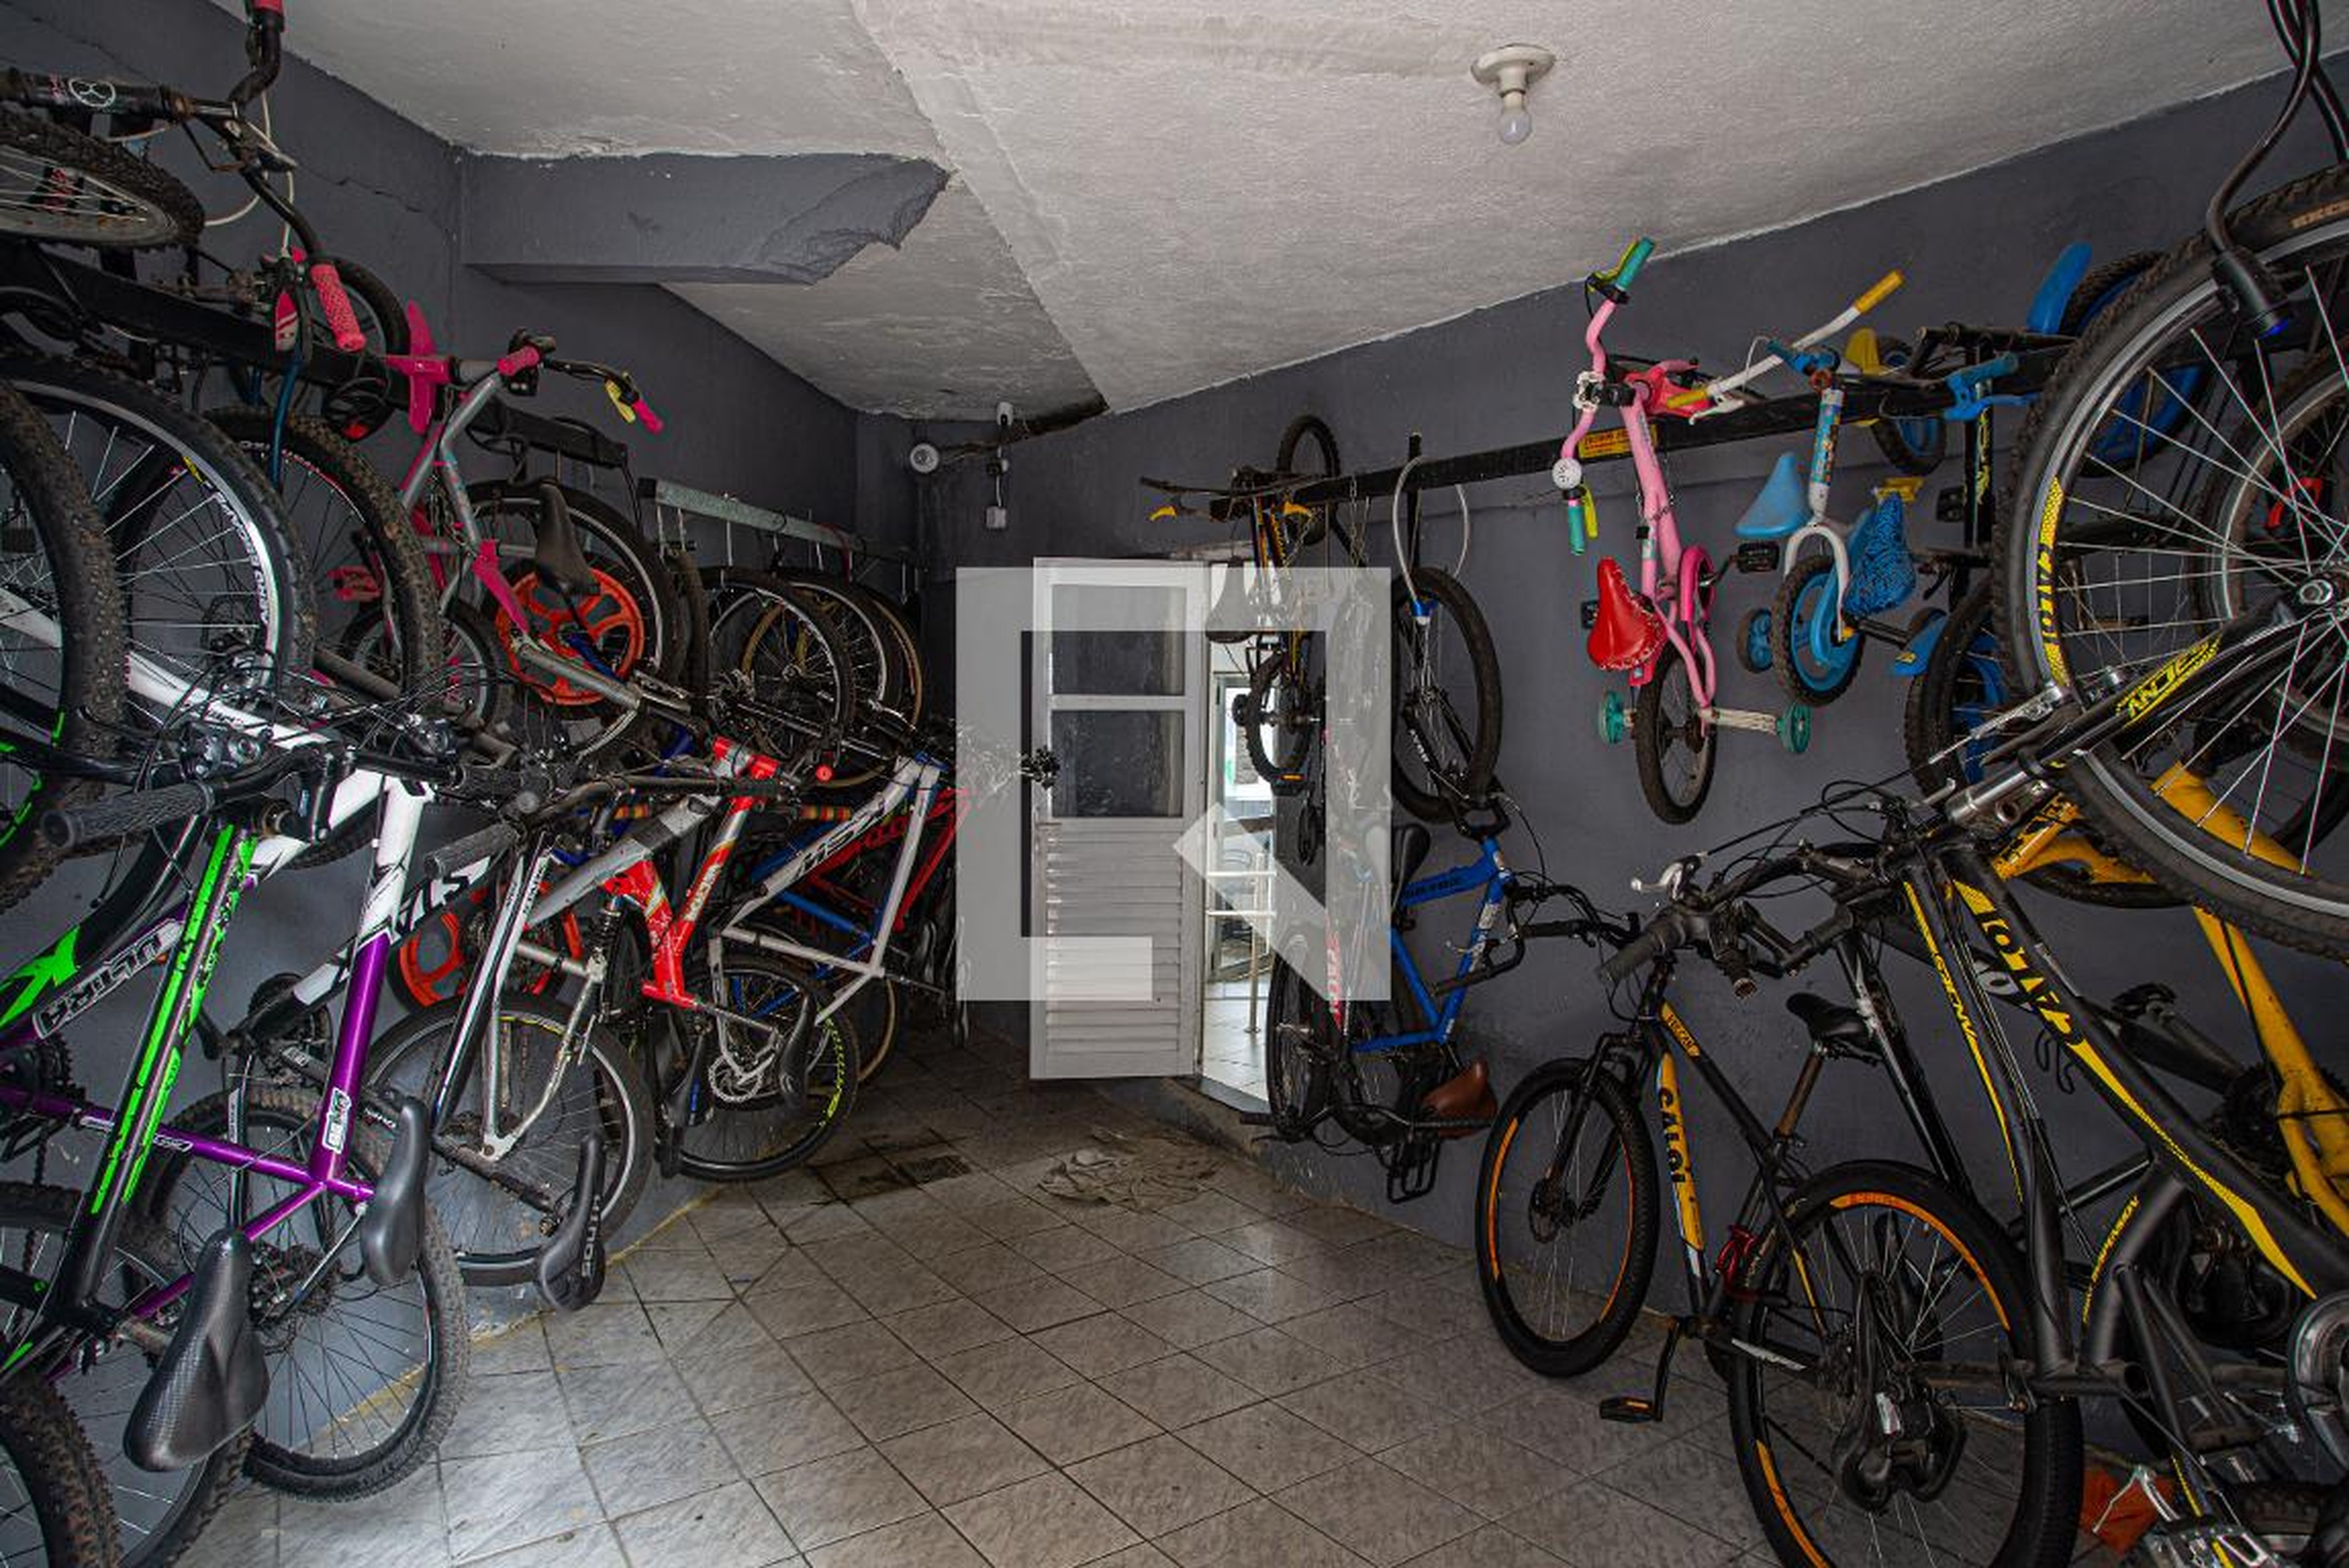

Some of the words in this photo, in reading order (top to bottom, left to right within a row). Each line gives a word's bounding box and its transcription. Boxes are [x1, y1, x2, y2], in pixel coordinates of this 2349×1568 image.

[42, 933, 163, 1036] ULTRA
[1980, 910, 2076, 1042] CALOI
[1658, 1088, 1685, 1185] CALOI
